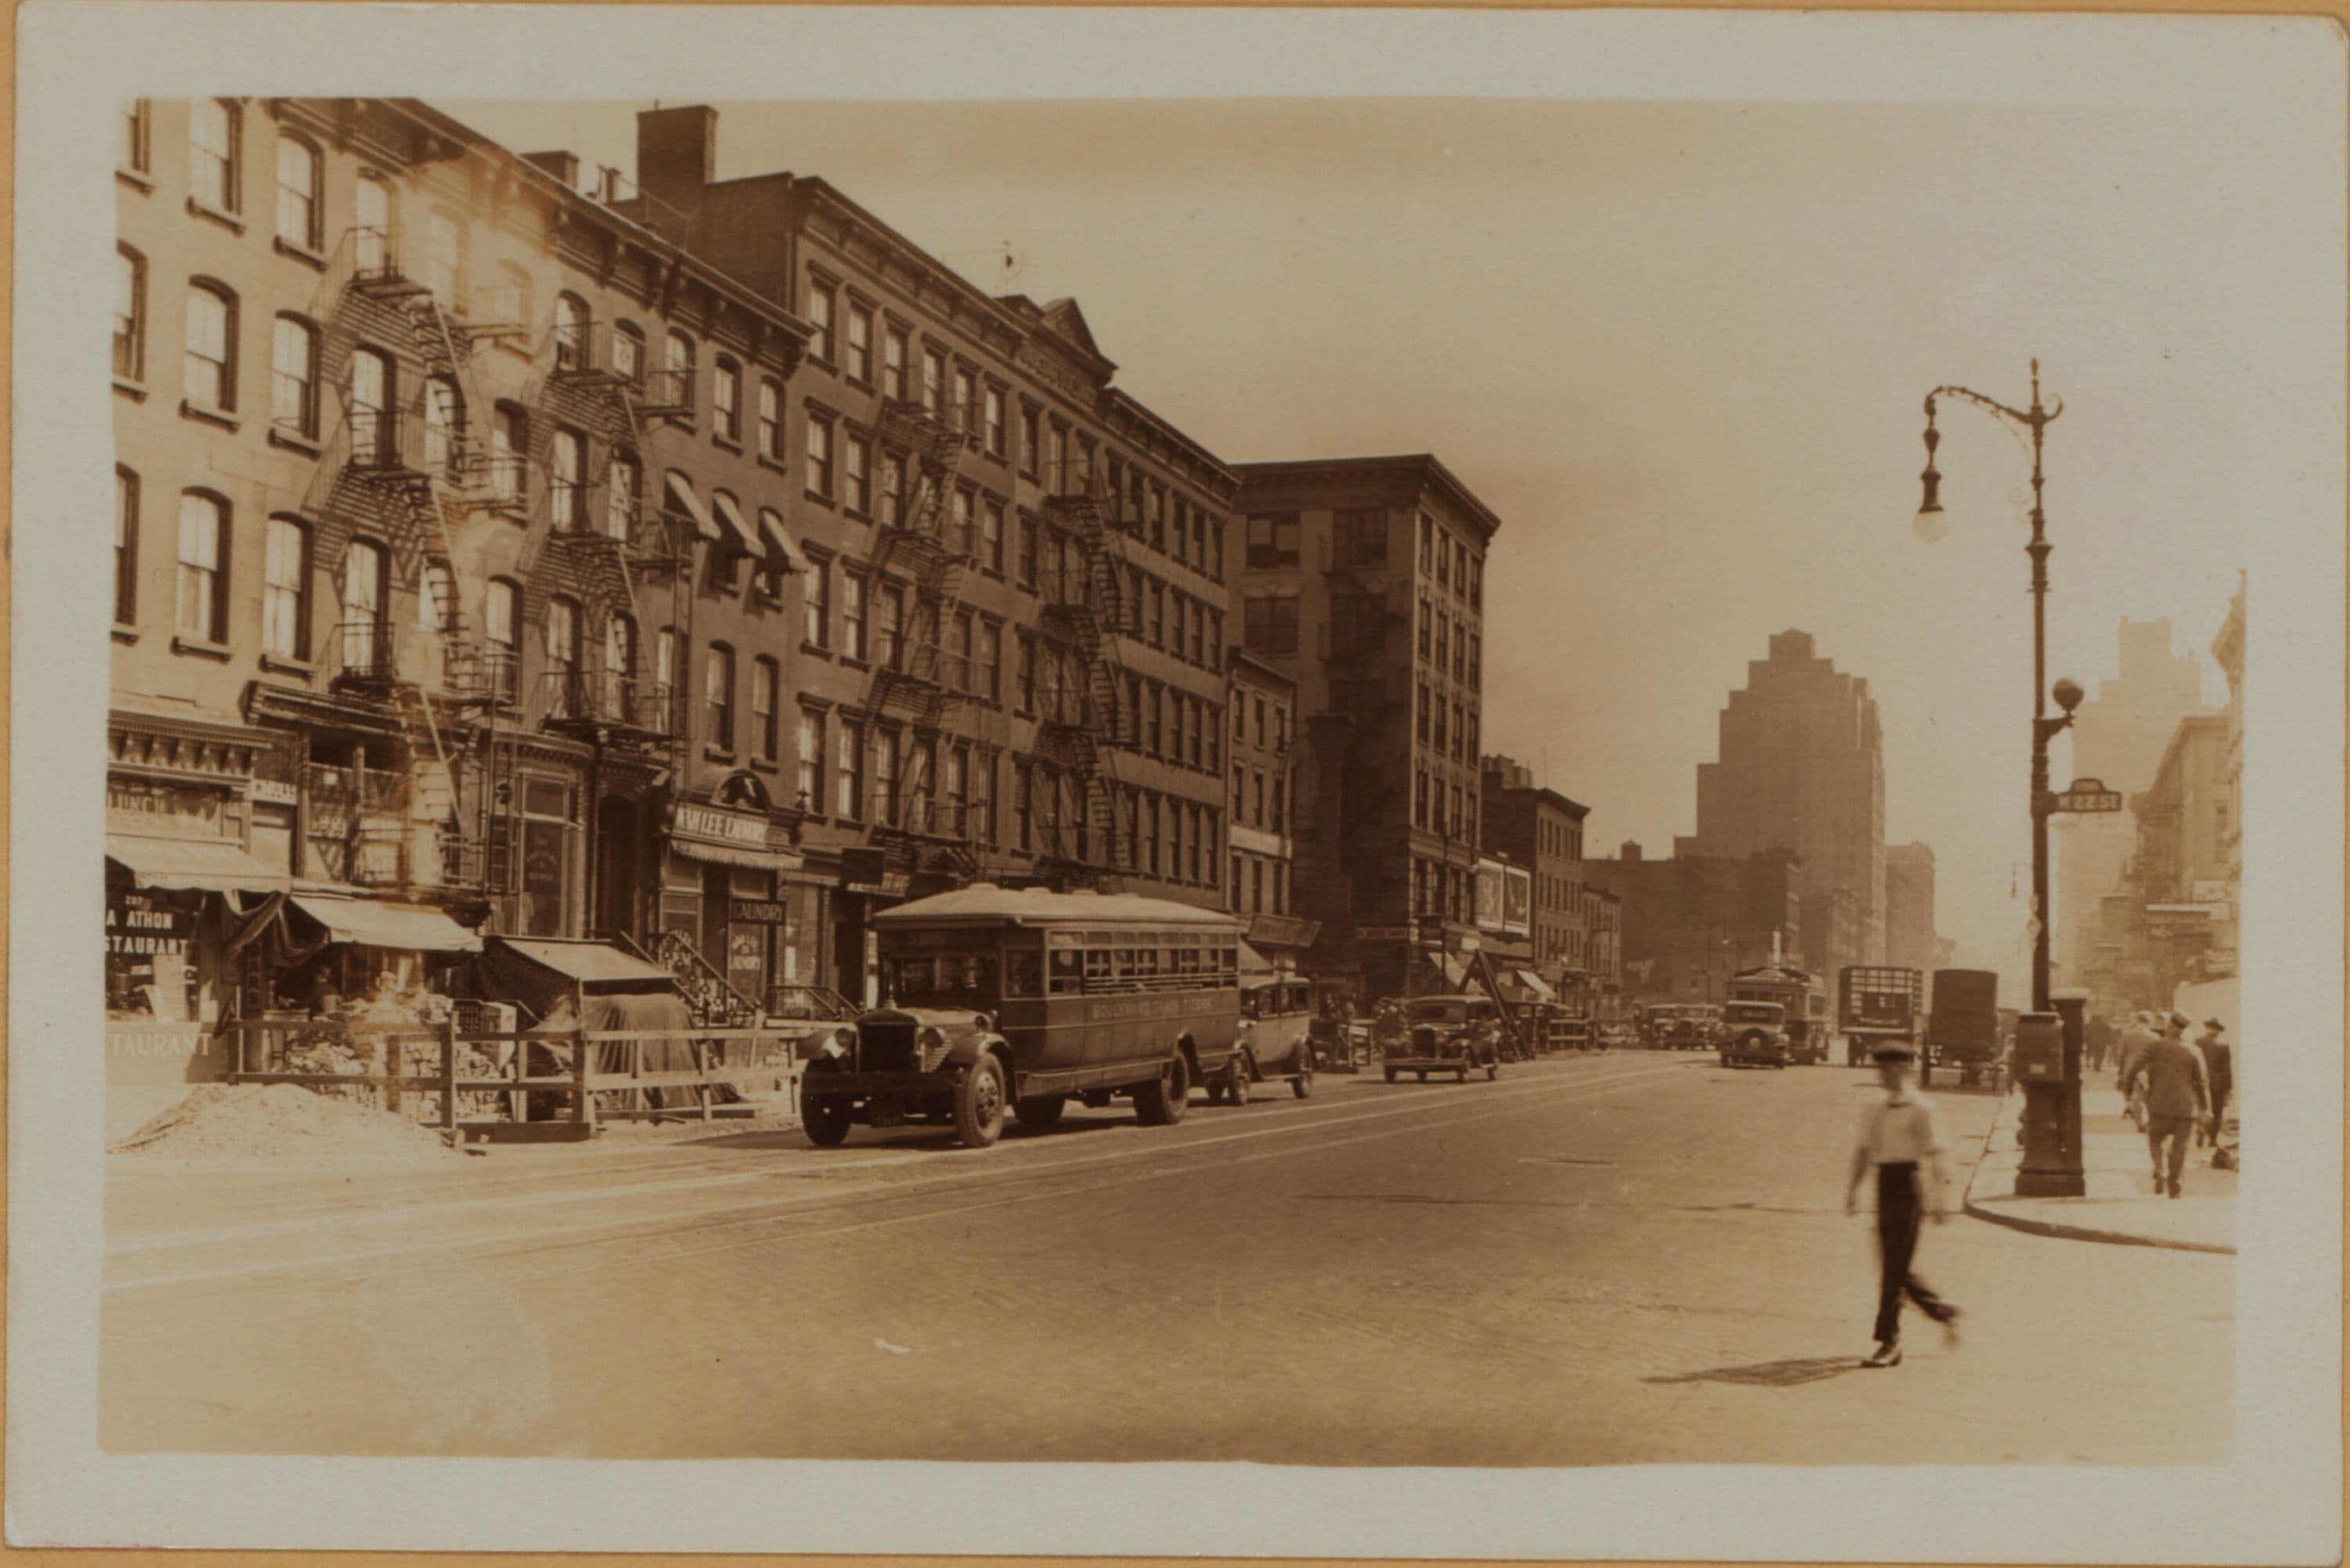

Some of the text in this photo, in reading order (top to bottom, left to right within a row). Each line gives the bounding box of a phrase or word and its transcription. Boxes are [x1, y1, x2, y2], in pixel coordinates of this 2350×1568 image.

[2074, 795, 2097, 810] 22
[701, 812, 725, 834] LEE
[112, 1033, 213, 1056] TAURANT
